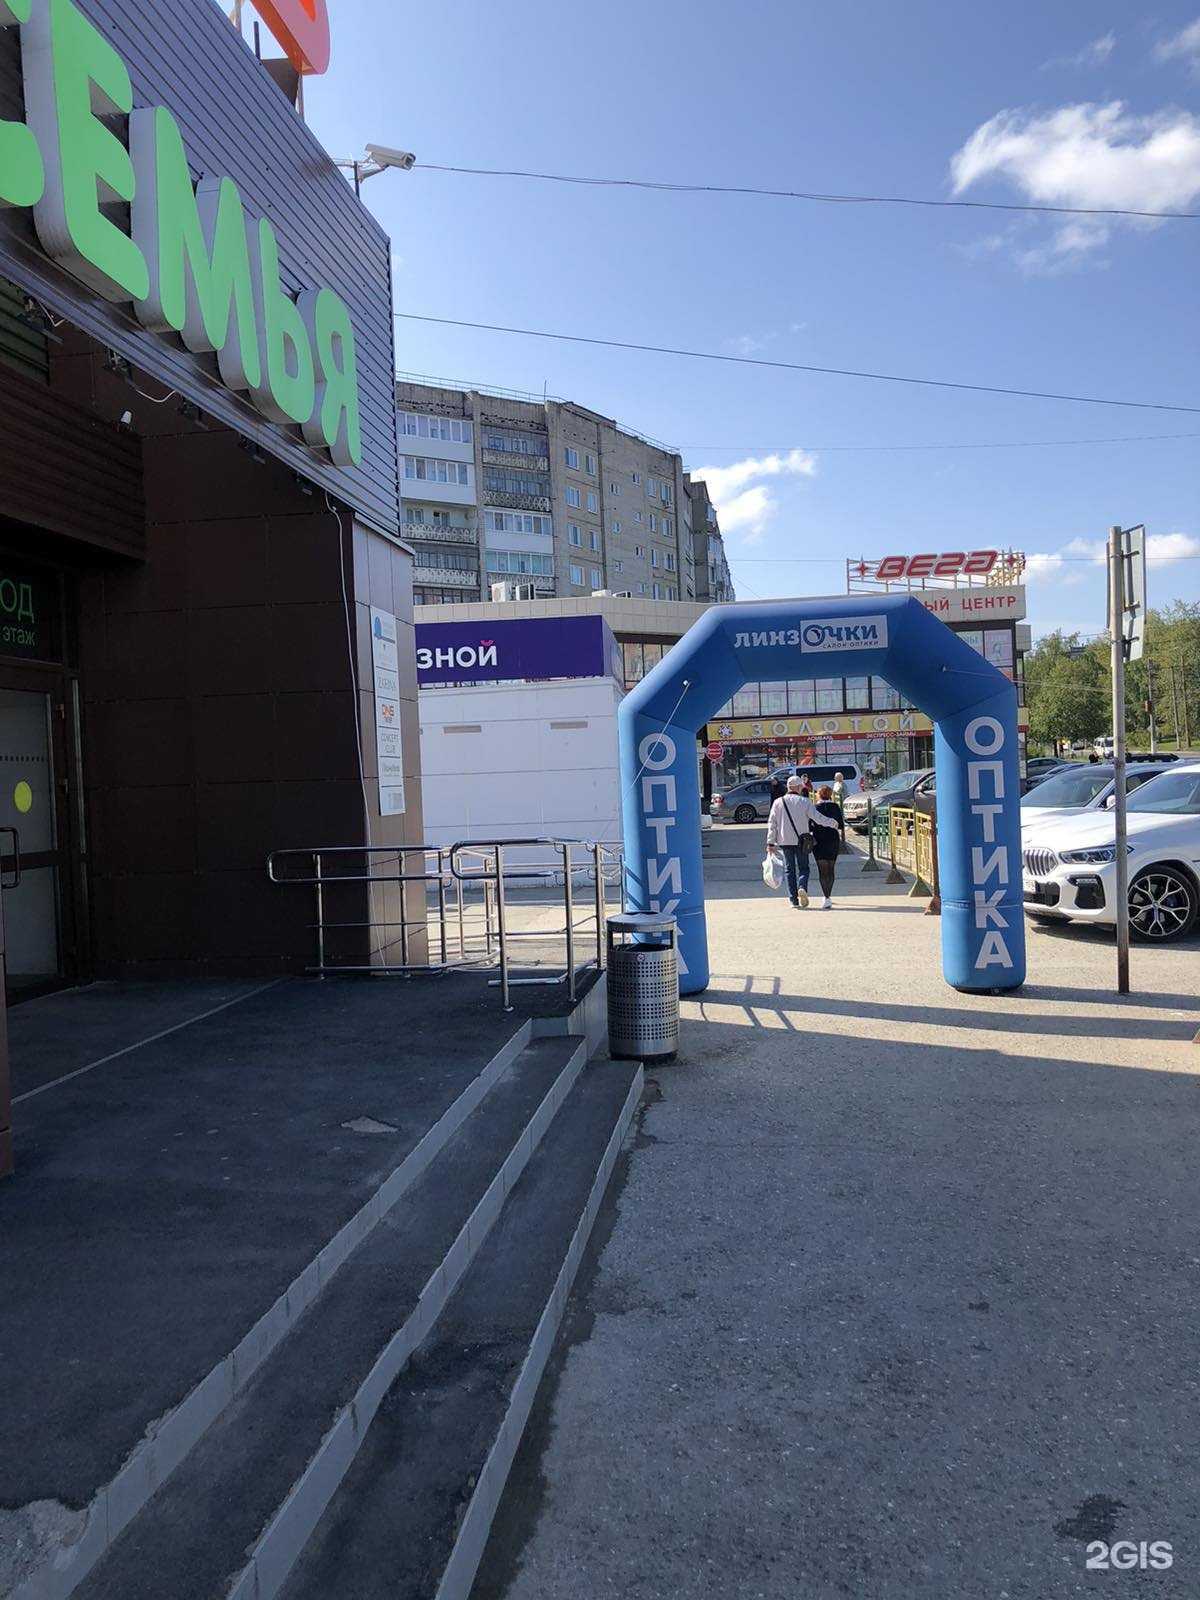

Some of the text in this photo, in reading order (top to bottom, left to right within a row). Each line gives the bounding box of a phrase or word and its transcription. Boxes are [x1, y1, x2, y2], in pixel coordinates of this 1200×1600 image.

[962, 595, 1017, 612] ЦЕНТР
[3, 625, 37, 647] этаж
[849, 640, 880, 648] ОПТИКИ
[416, 640, 499, 670] ЗНОЙ
[751, 711, 915, 737] ЗОЛОТОЙ
[964, 716, 1014, 970] ОПТИКА
